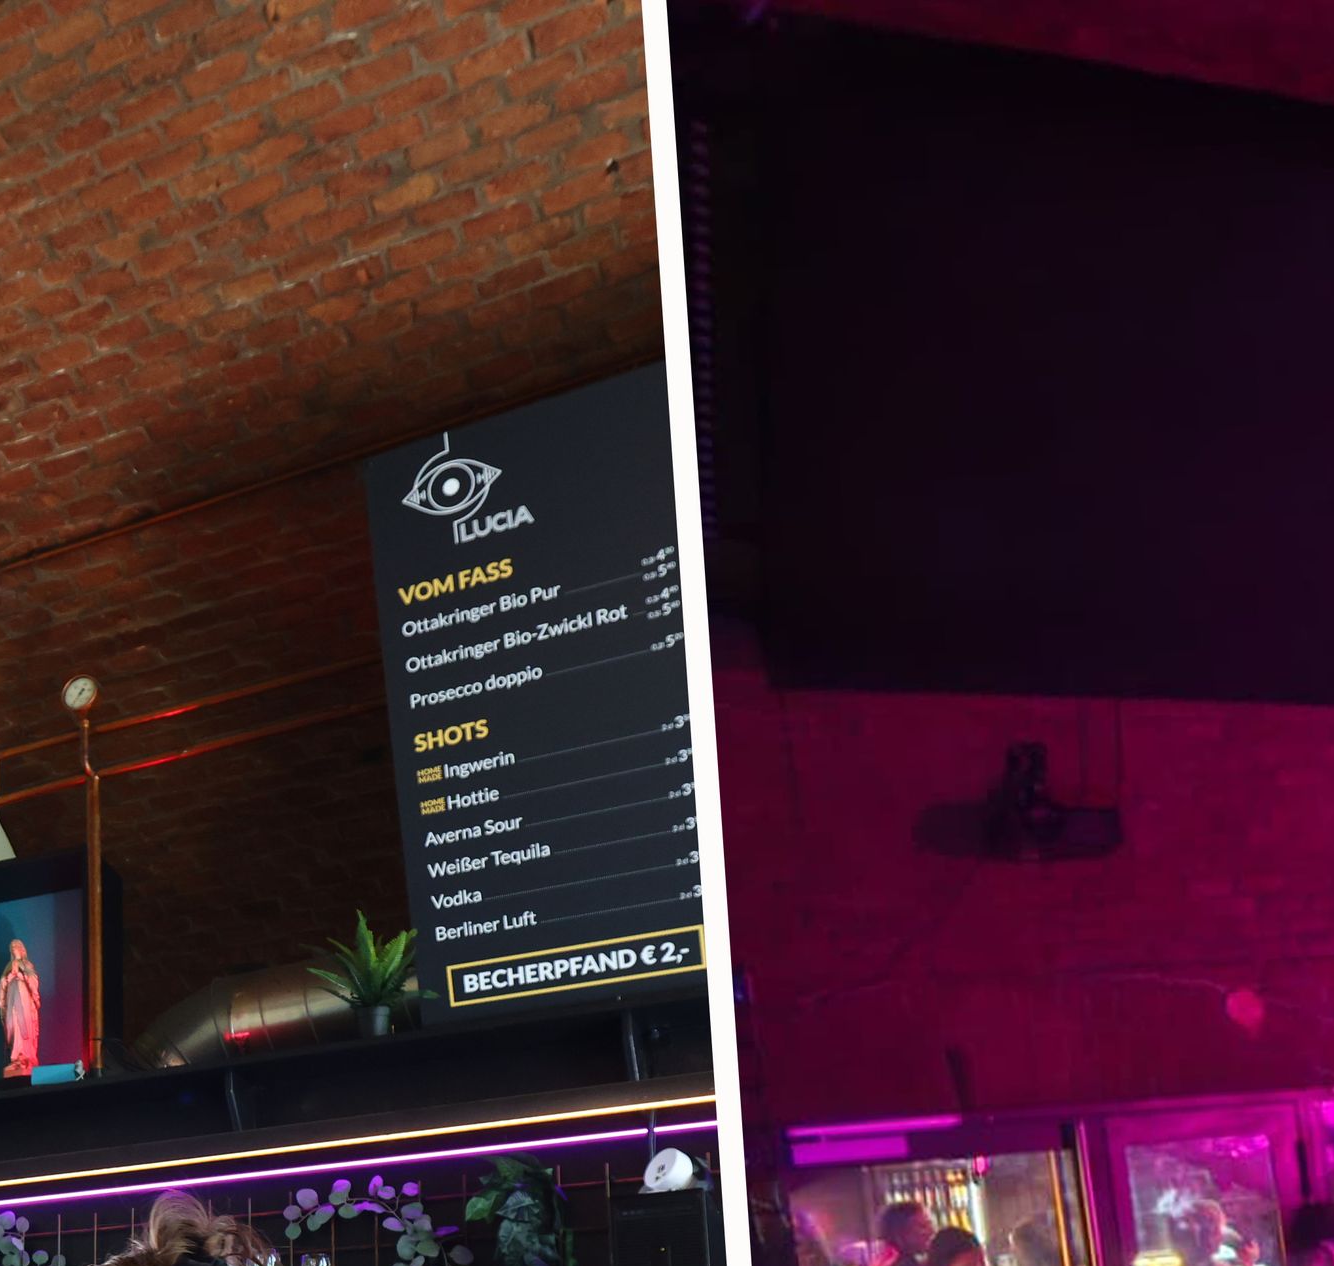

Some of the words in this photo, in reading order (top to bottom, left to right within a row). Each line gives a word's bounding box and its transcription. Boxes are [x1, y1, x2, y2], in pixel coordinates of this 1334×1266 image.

[458, 504, 536, 544] LUCIA
[397, 574, 455, 606] VOM
[458, 558, 514, 590] FASS
[401, 601, 497, 637] Ottakringer
[499, 593, 528, 612] Bio
[530, 584, 561, 604] Pur
[405, 638, 501, 673] Ottakringer
[503, 611, 593, 649] Bio-Zwickl
[596, 604, 629, 626] Rot
[410, 681, 483, 709] Prosecco
[485, 665, 543, 691] doppio
[414, 719, 489, 752] SHOTS
[417, 765, 442, 778] HOME
[418, 773, 443, 784] MADE
[444, 751, 515, 779] Ingwerin
[420, 797, 445, 809] HOME
[421, 805, 446, 816] MADE
[447, 787, 500, 810] Hottie
[424, 825, 482, 848] Averna
[484, 817, 523, 836] Sour
[427, 856, 488, 878] Weißer
[490, 843, 551, 866] Tequila
[430, 889, 482, 910] Vodka
[435, 920, 500, 942] Berliner
[503, 910, 537, 930] Luft
[463, 949, 638, 994] BECHERPFAND
[640, 945, 657, 966] €
[660, 941, 690, 964] 2,-
